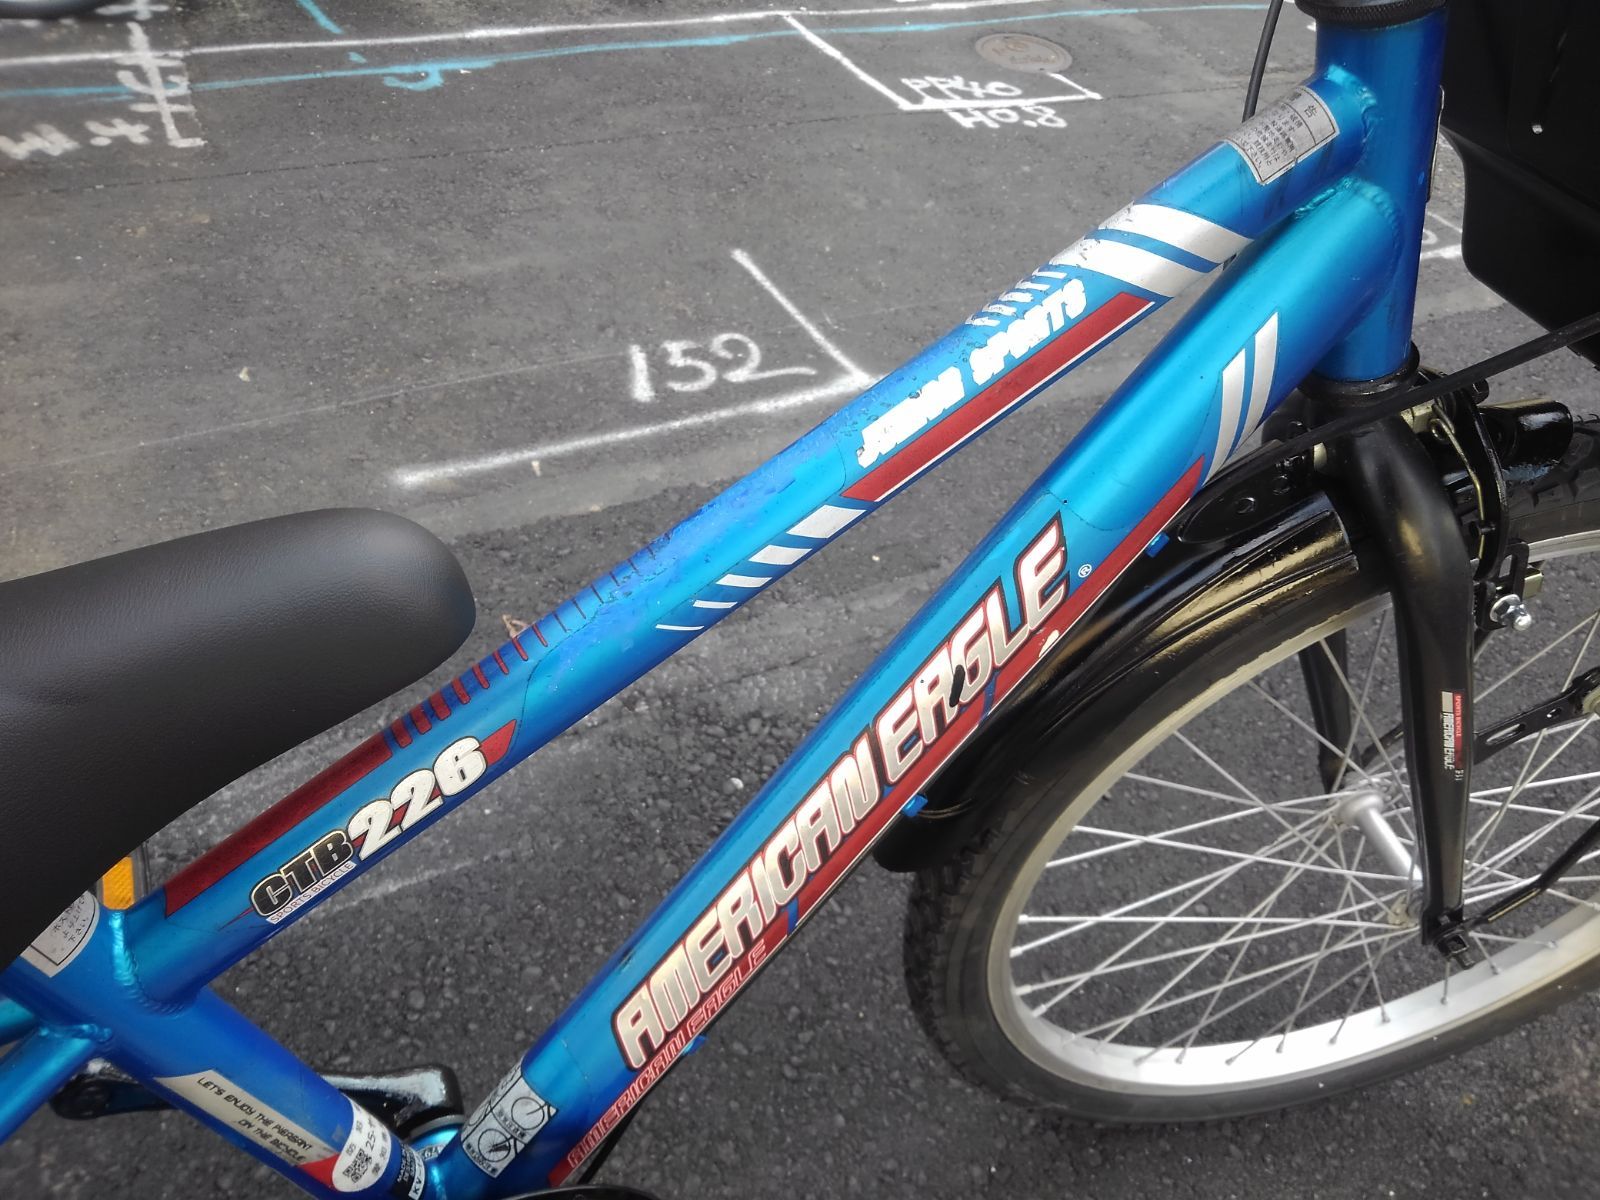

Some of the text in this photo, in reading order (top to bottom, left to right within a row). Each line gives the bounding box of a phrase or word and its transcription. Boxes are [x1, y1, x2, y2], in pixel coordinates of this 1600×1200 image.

[630, 332, 817, 402] 152
[251, 735, 488, 917] CTB 226
[612, 511, 1070, 1071] AMERICAN EAGLE
[270, 862, 355, 923] SPORTS BICYCLE
[223, 1094, 256, 1116] ENJOY
[567, 938, 767, 1168] AMERICAN EAGLE
